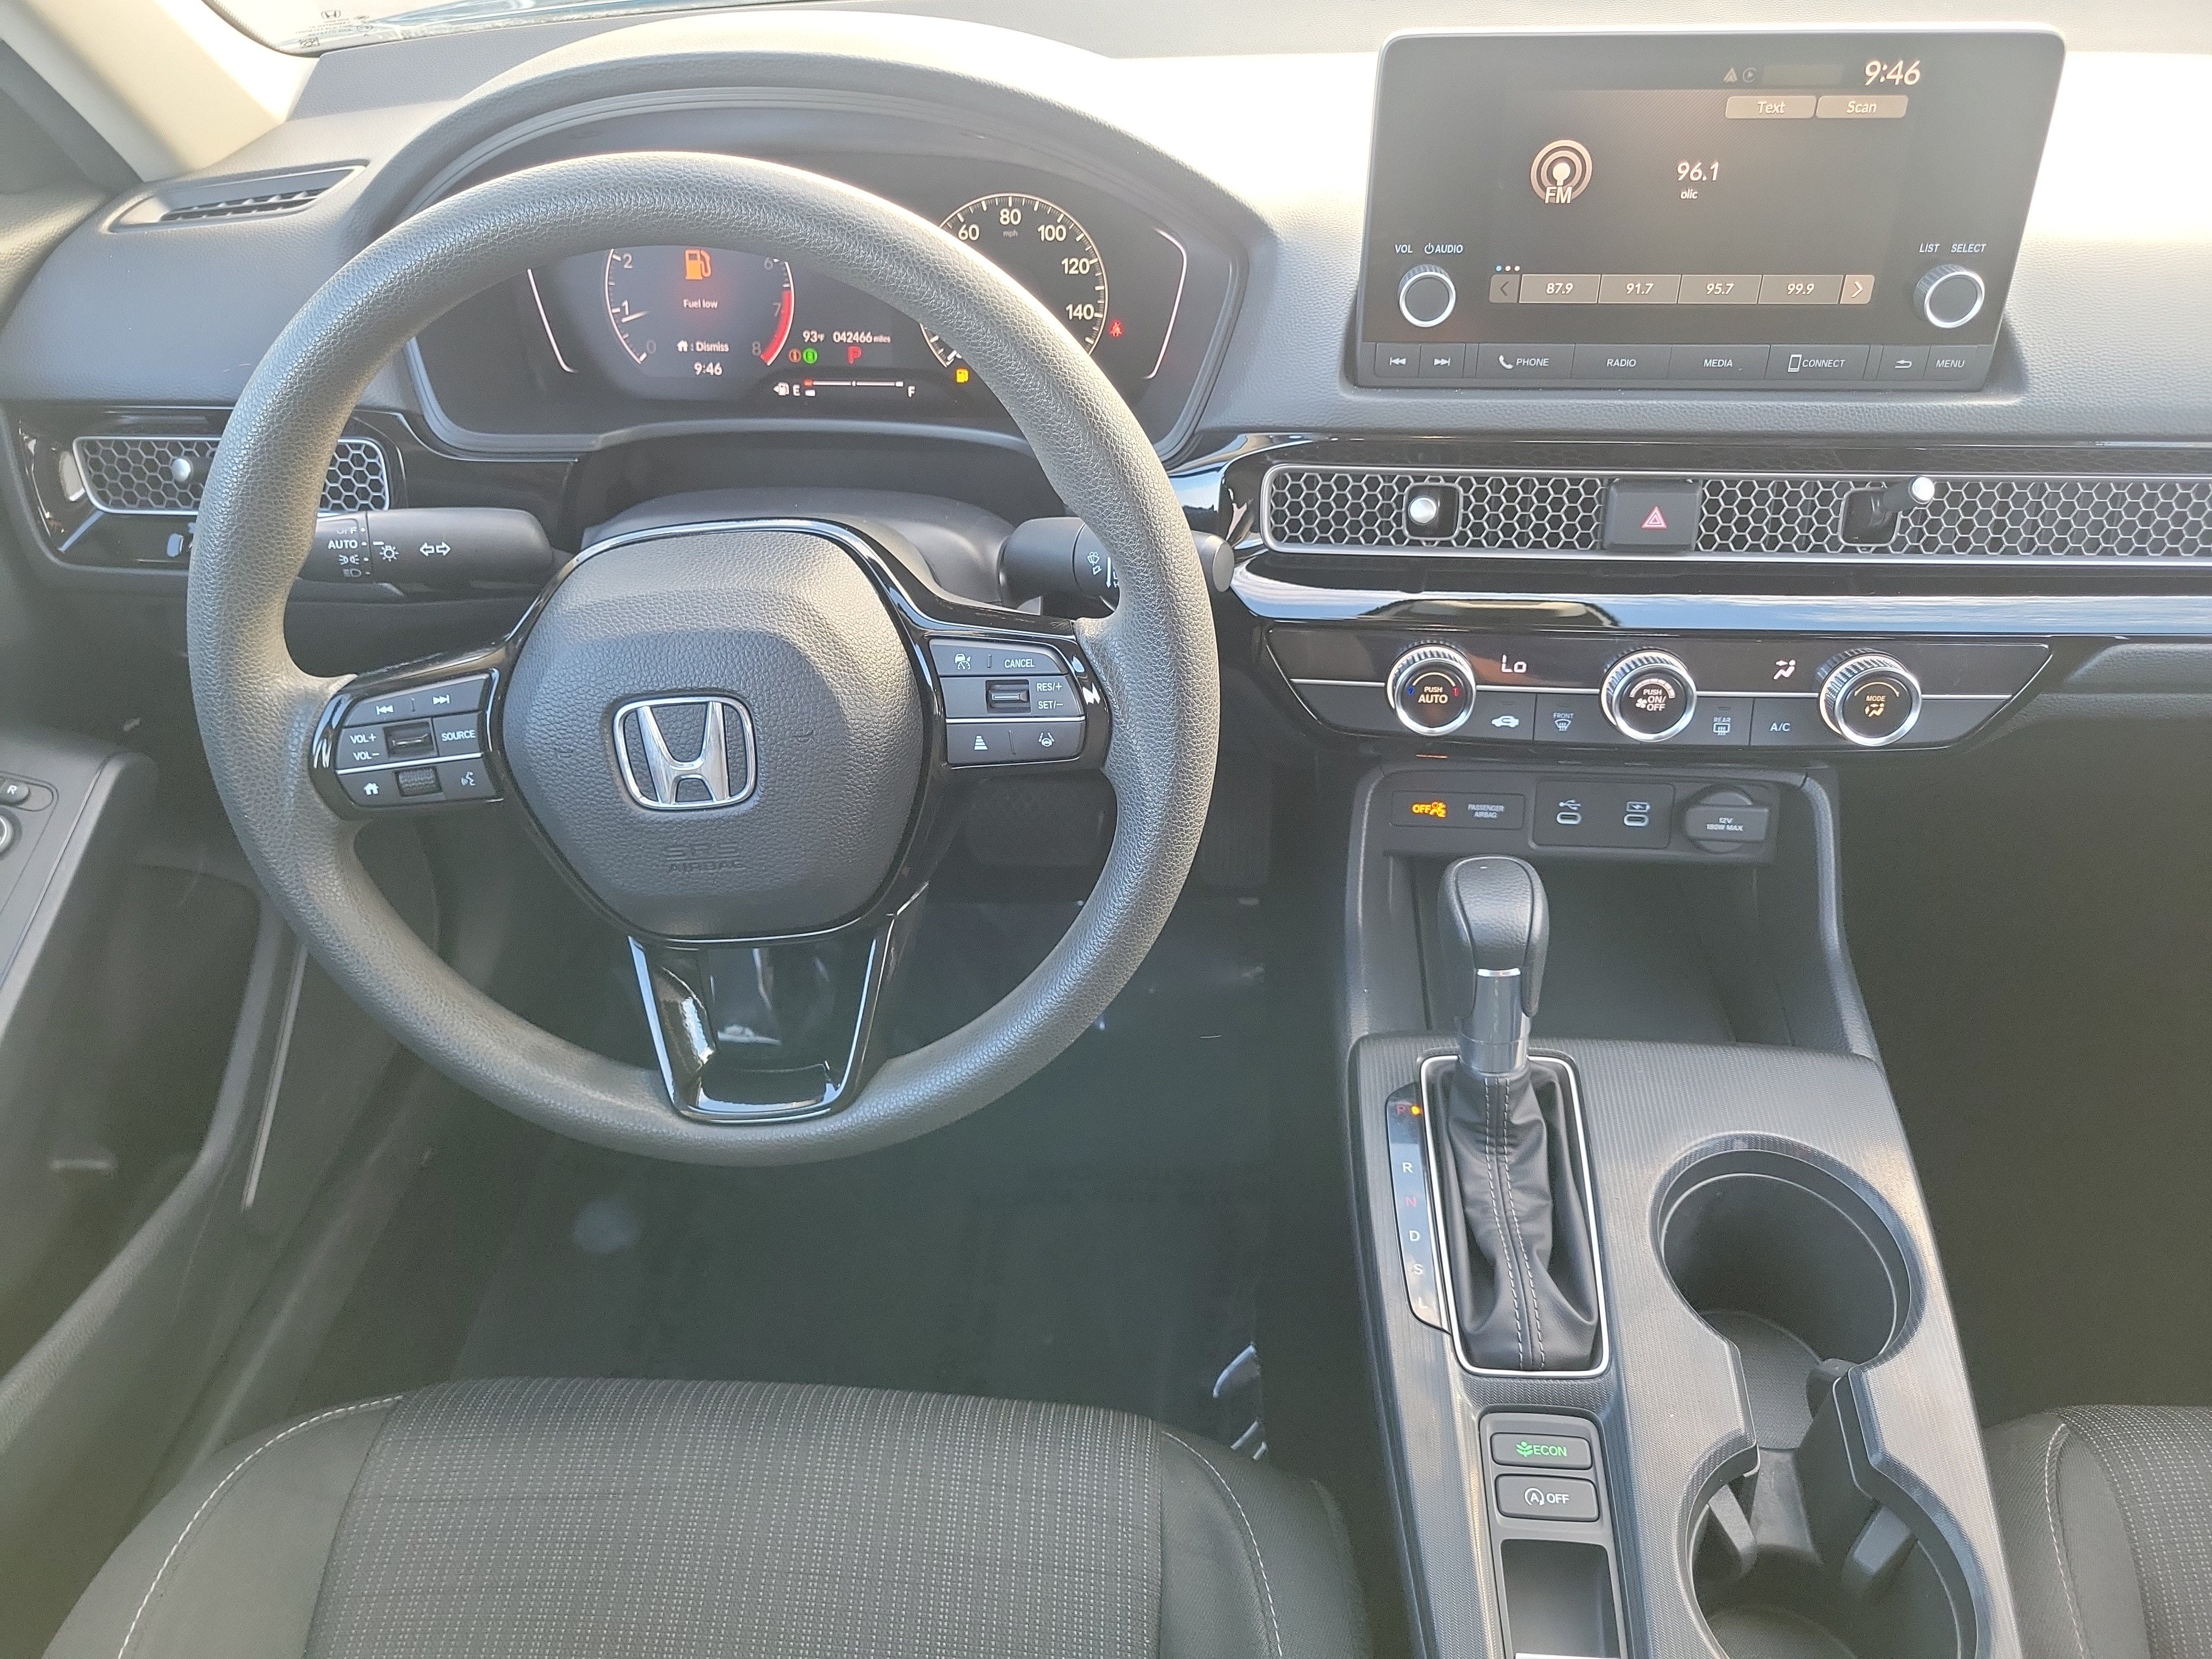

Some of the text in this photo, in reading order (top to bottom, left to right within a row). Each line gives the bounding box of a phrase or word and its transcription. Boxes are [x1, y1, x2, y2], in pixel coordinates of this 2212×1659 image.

[1864, 59, 1921, 86] 9:46
[1757, 100, 1786, 115] Text
[1846, 100, 1877, 114] Scan
[1676, 161, 1720, 182] 96.1
[1544, 185, 1573, 205] FM
[1680, 188, 1699, 200] olic
[999, 208, 1022, 225] 80
[958, 224, 980, 240] 60
[1003, 229, 1018, 240] mph
[1037, 225, 1066, 241] 100
[1395, 244, 1413, 254] VOL
[1434, 244, 1464, 254] AUDIO
[1919, 243, 1940, 253] LIST
[1950, 243, 1987, 253] SELECT
[623, 255, 633, 268] 2
[764, 258, 773, 269] 6
[1061, 257, 1090, 275] 120
[1545, 283, 1573, 295] 87.9
[1626, 283, 1654, 295] 91.7
[1706, 283, 1734, 295] 95.7
[1786, 283, 1814, 295] 99.9
[622, 301, 629, 315] 1
[684, 298, 718, 309] Fuel low
[772, 302, 782, 317] 7
[1065, 304, 1094, 320] 140
[833, 331, 872, 343] 042466
[646, 341, 656, 354] 0
[696, 341, 729, 353] Dismiss
[752, 342, 761, 356] 8
[848, 346, 862, 364] P
[1515, 357, 1550, 367] PHONE
[1606, 358, 1637, 368] RADIO
[1703, 358, 1733, 368] MEDIA
[1802, 359, 1846, 368] CONNECT
[1936, 359, 1965, 369] MENU
[694, 362, 723, 376] 9:46
[793, 384, 801, 397] E
[907, 385, 916, 398] F
[328, 539, 358, 550] AUTO
[1005, 658, 1035, 668] CANCEL
[1036, 682, 1063, 692] RES/+
[1418, 694, 1448, 704] AUTO
[1646, 703, 1666, 712] OFF
[1769, 722, 1791, 732] A/C
[349, 732, 377, 744] VOL+
[441, 730, 476, 742] SOURCE
[7, 785, 17, 795] R
[1412, 804, 1431, 814] OFF
[1468, 803, 1504, 812] PASSENGER
[1397, 1105, 1406, 1115] P
[1402, 1162, 1413, 1173] R
[1406, 1197, 1417, 1207] N
[1409, 1230, 1420, 1242] D
[1414, 1264, 1423, 1275] S
[1419, 1297, 1428, 1309] L
[1533, 1444, 1567, 1457] ECON
[1546, 1493, 1570, 1504] OFF
